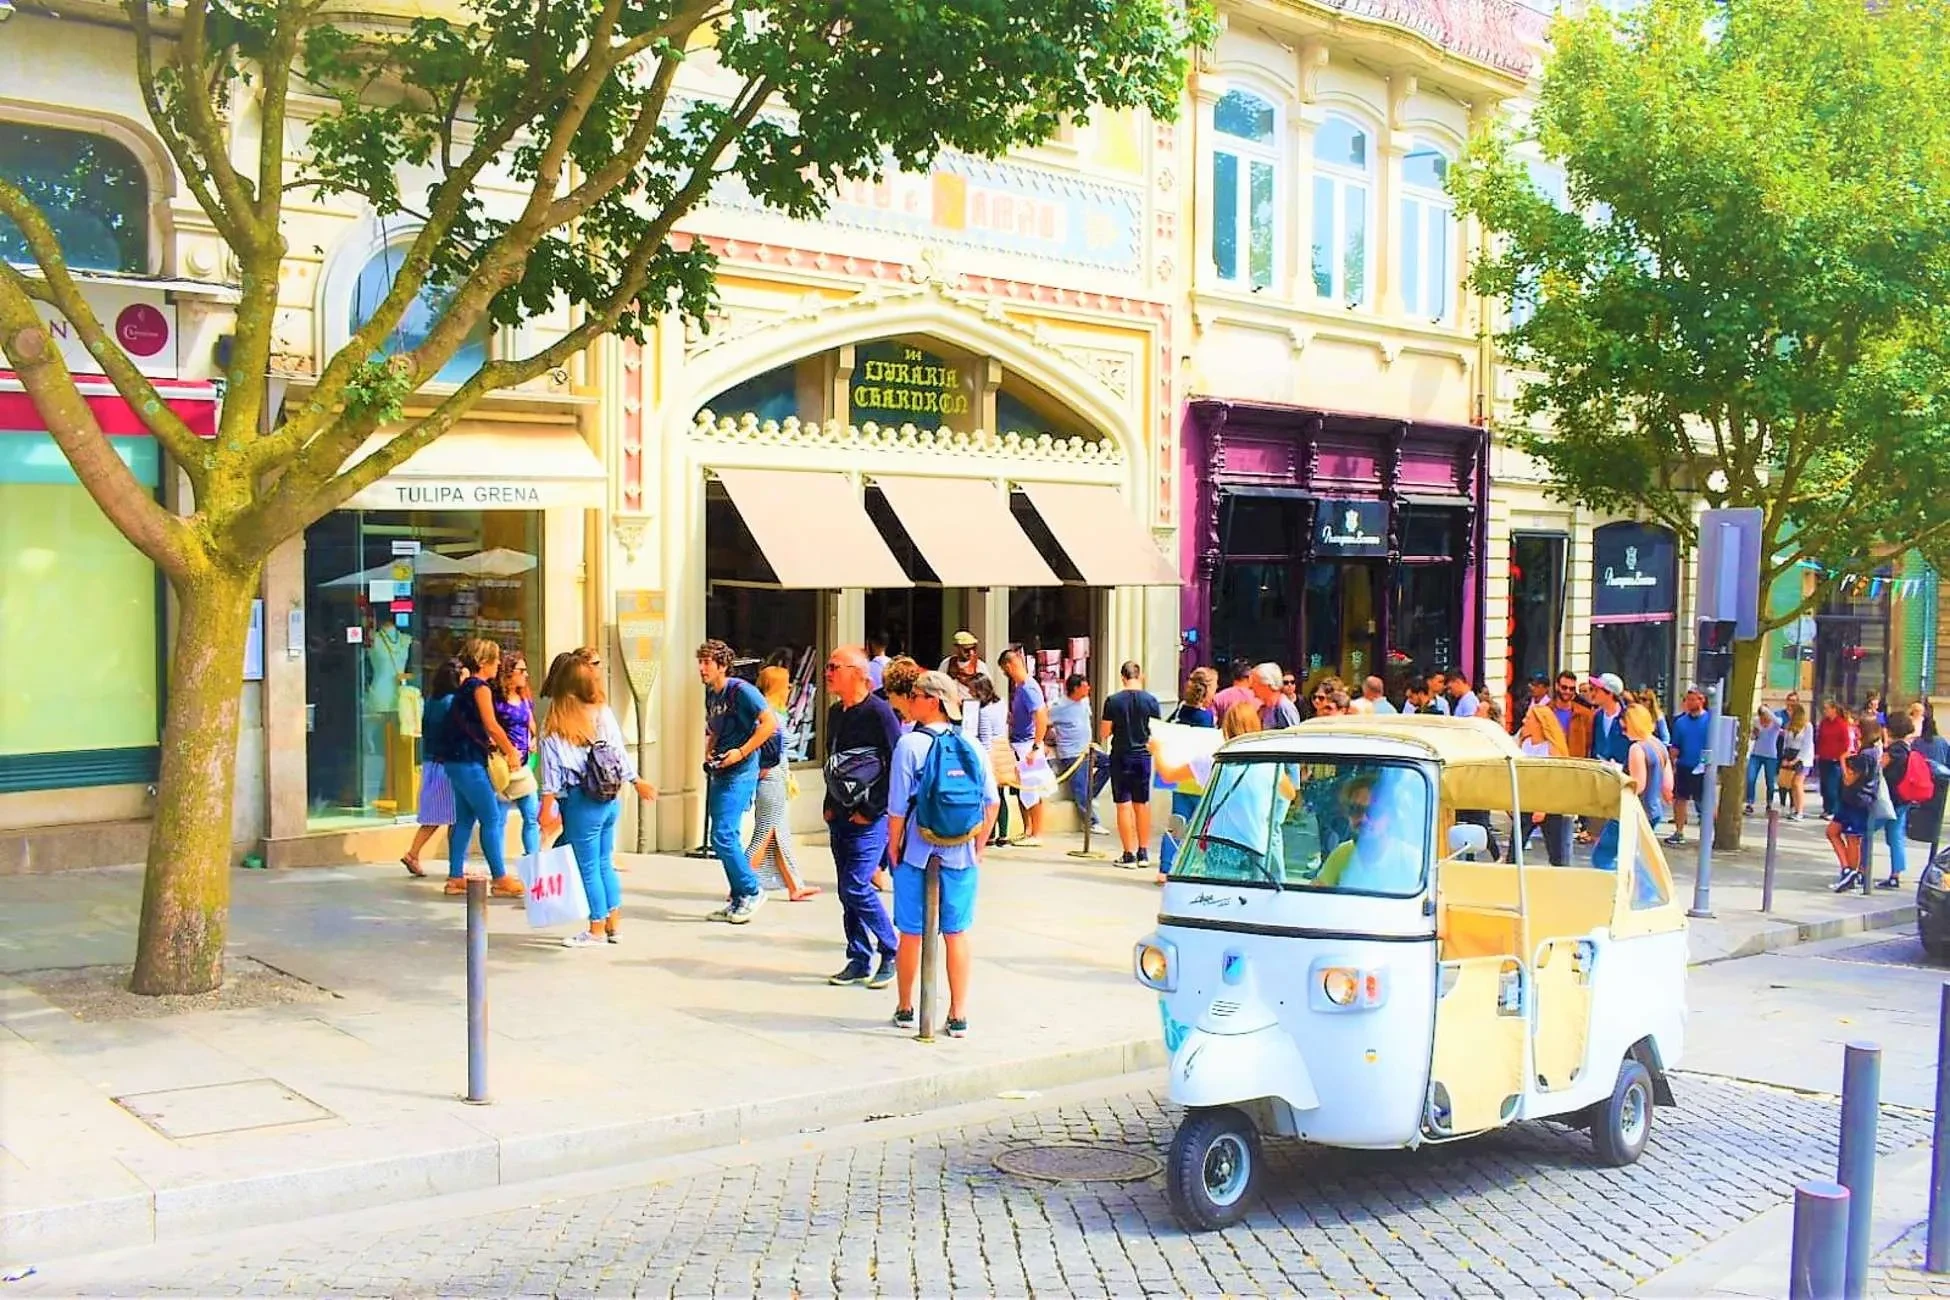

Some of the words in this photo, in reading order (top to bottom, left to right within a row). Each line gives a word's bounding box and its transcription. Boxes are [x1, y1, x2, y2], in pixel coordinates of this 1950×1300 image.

[865, 360, 959, 389] LIVRARIA
[854, 385, 968, 414] CHARDRON
[395, 486, 465, 503] TULIPA
[473, 486, 540, 503] GRENA
[530, 873, 563, 901] HM
